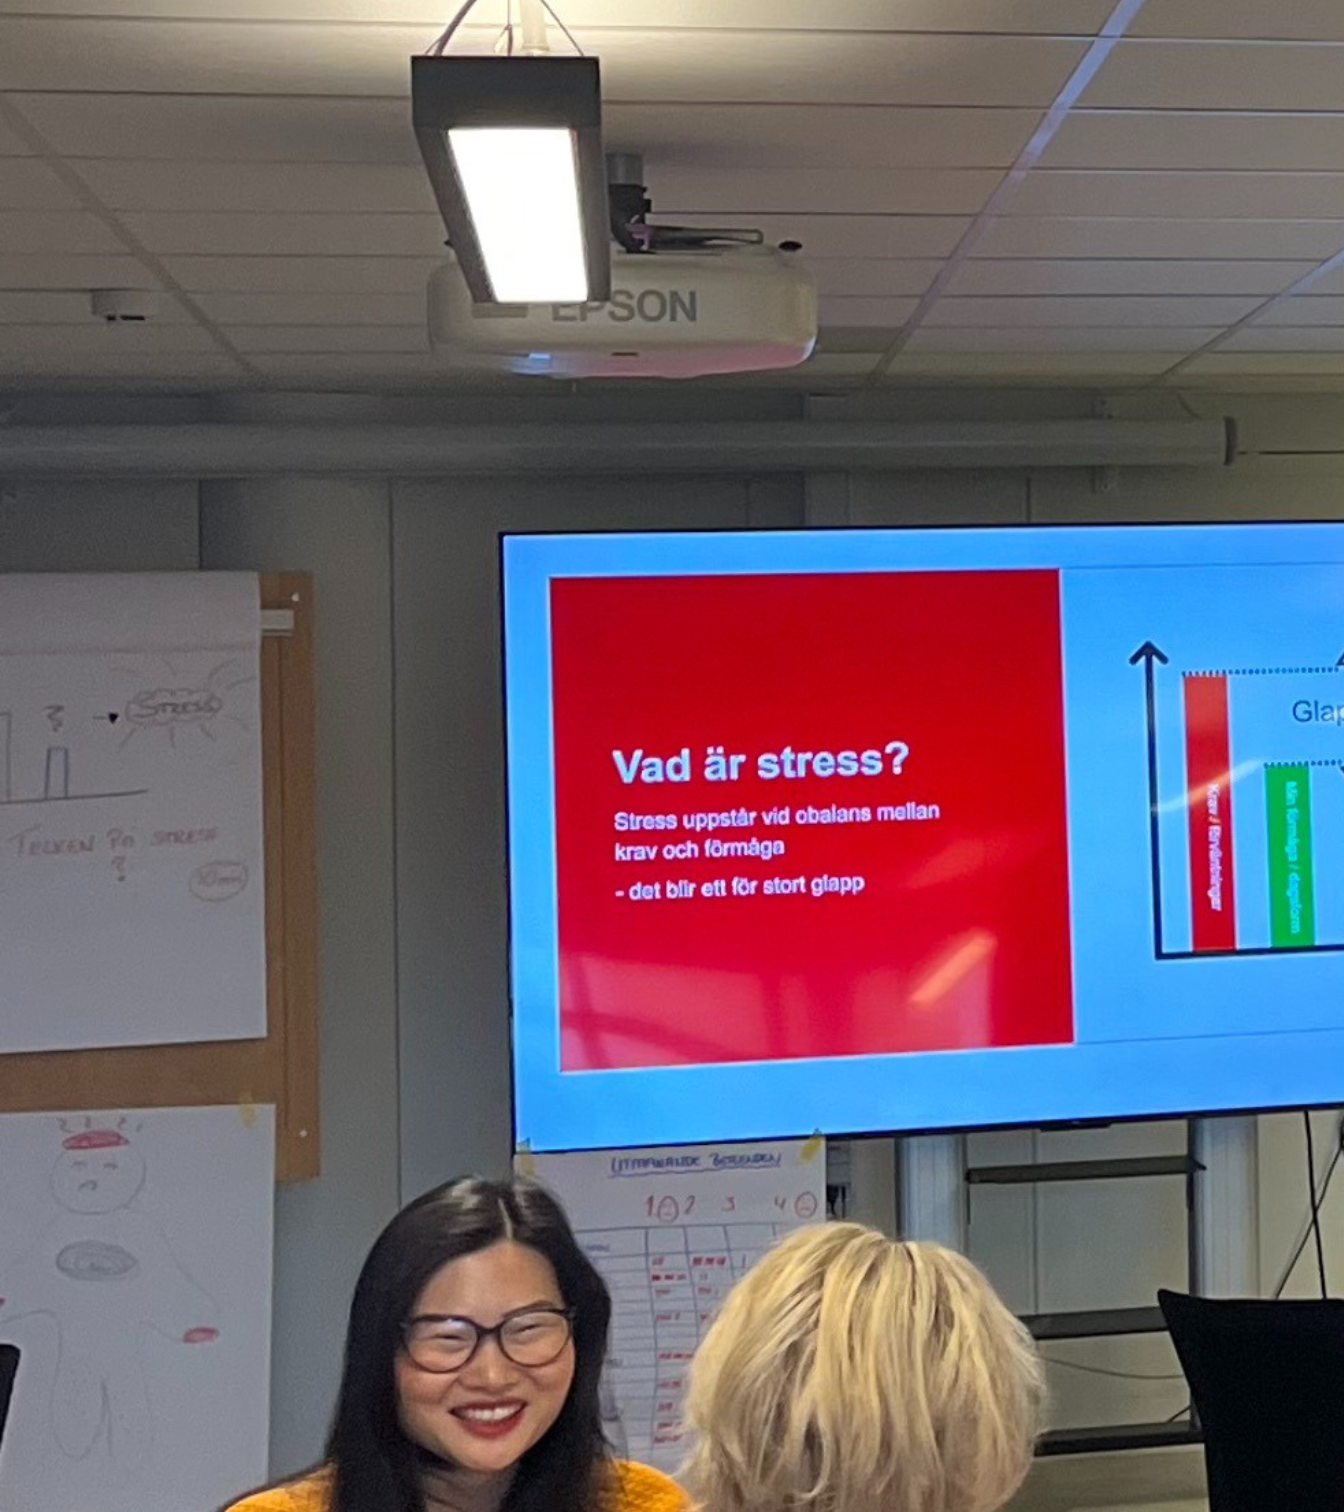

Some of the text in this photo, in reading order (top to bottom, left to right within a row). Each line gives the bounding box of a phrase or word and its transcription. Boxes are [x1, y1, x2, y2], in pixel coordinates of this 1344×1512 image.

[612, 741, 910, 783] Vad är stress?
[614, 802, 940, 832] Stress uppstår vid obalans mellan
[614, 838, 785, 861] krav och förmåga
[629, 881, 661, 901] det
[666, 880, 697, 899] blir
[701, 879, 727, 897] ett
[731, 877, 757, 896] för
[763, 875, 805, 895] stort
[810, 874, 865, 895] glapp
